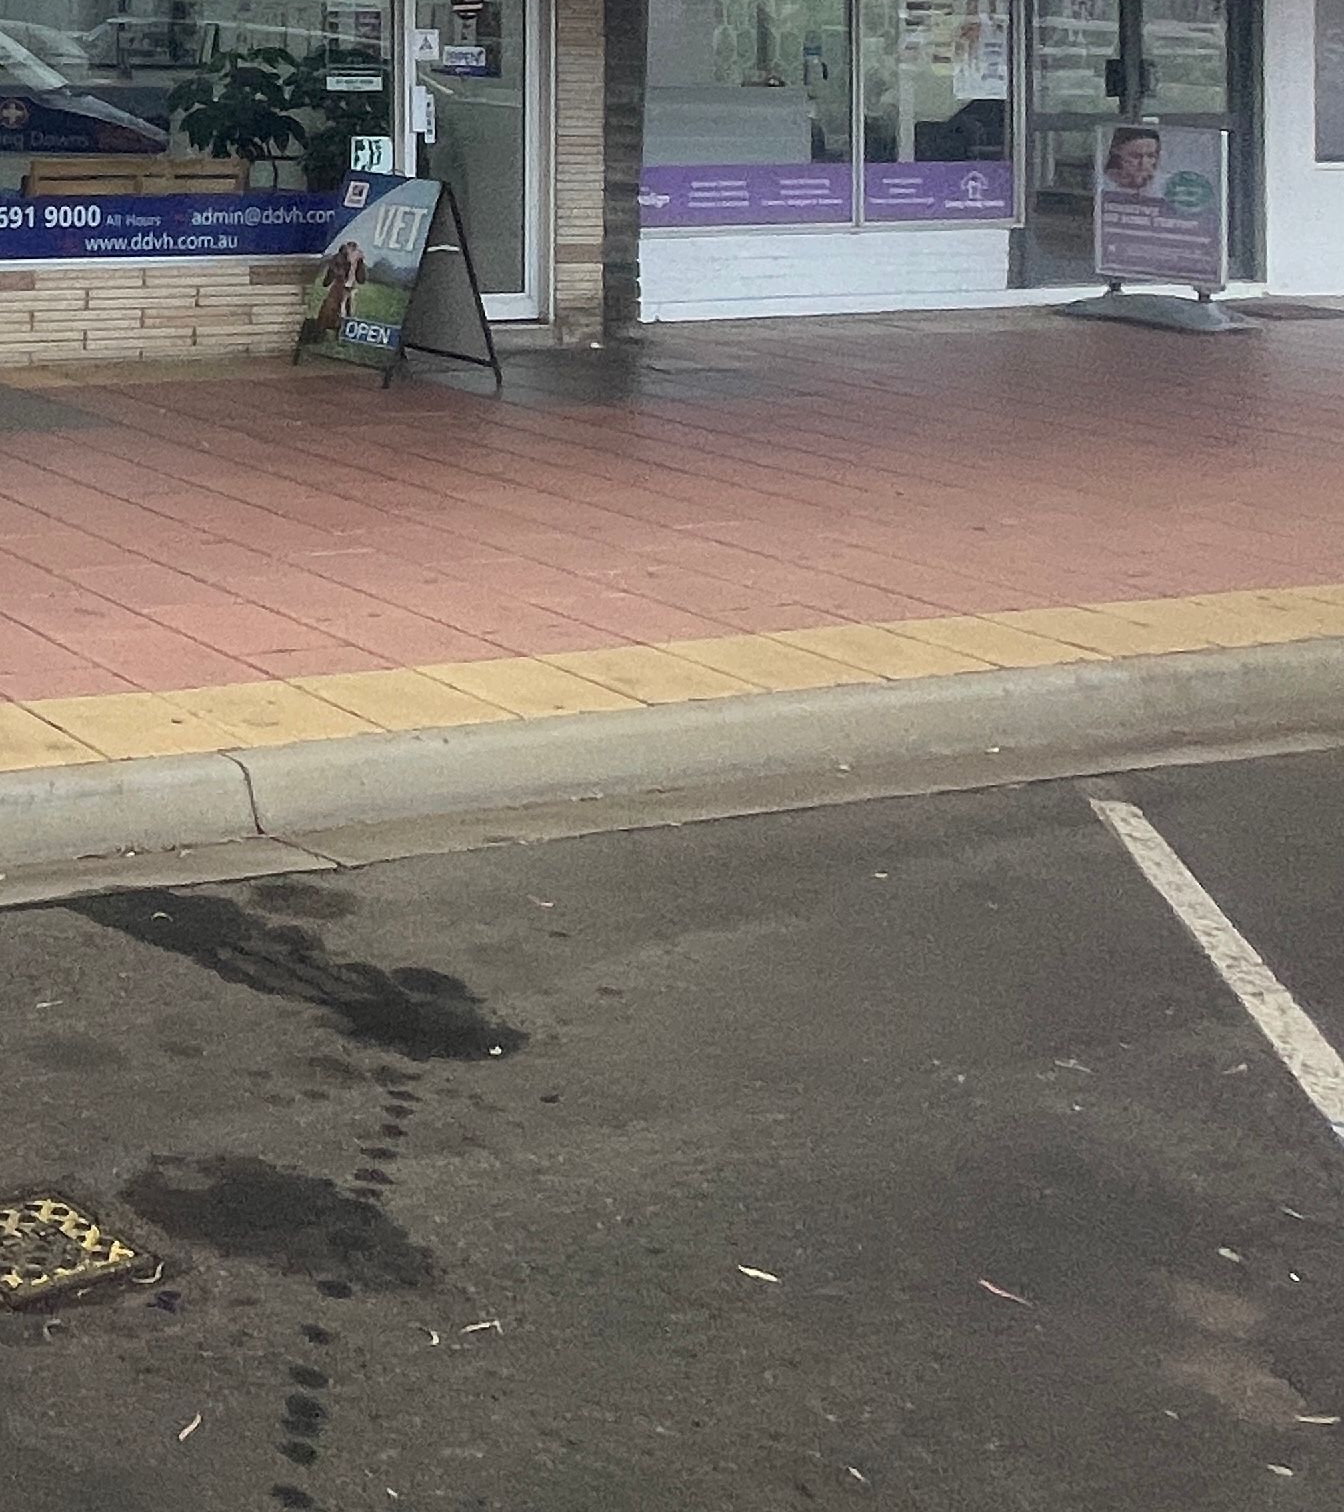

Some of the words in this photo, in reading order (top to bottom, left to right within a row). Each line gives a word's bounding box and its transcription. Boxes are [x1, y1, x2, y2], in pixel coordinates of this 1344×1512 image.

[44, 205, 102, 228] 9000
[105, 215, 122, 227] All
[125, 214, 162, 227] Hours
[374, 203, 428, 251] VET
[85, 232, 238, 252] www.ddvh.com.au
[346, 320, 390, 344] OPEN
